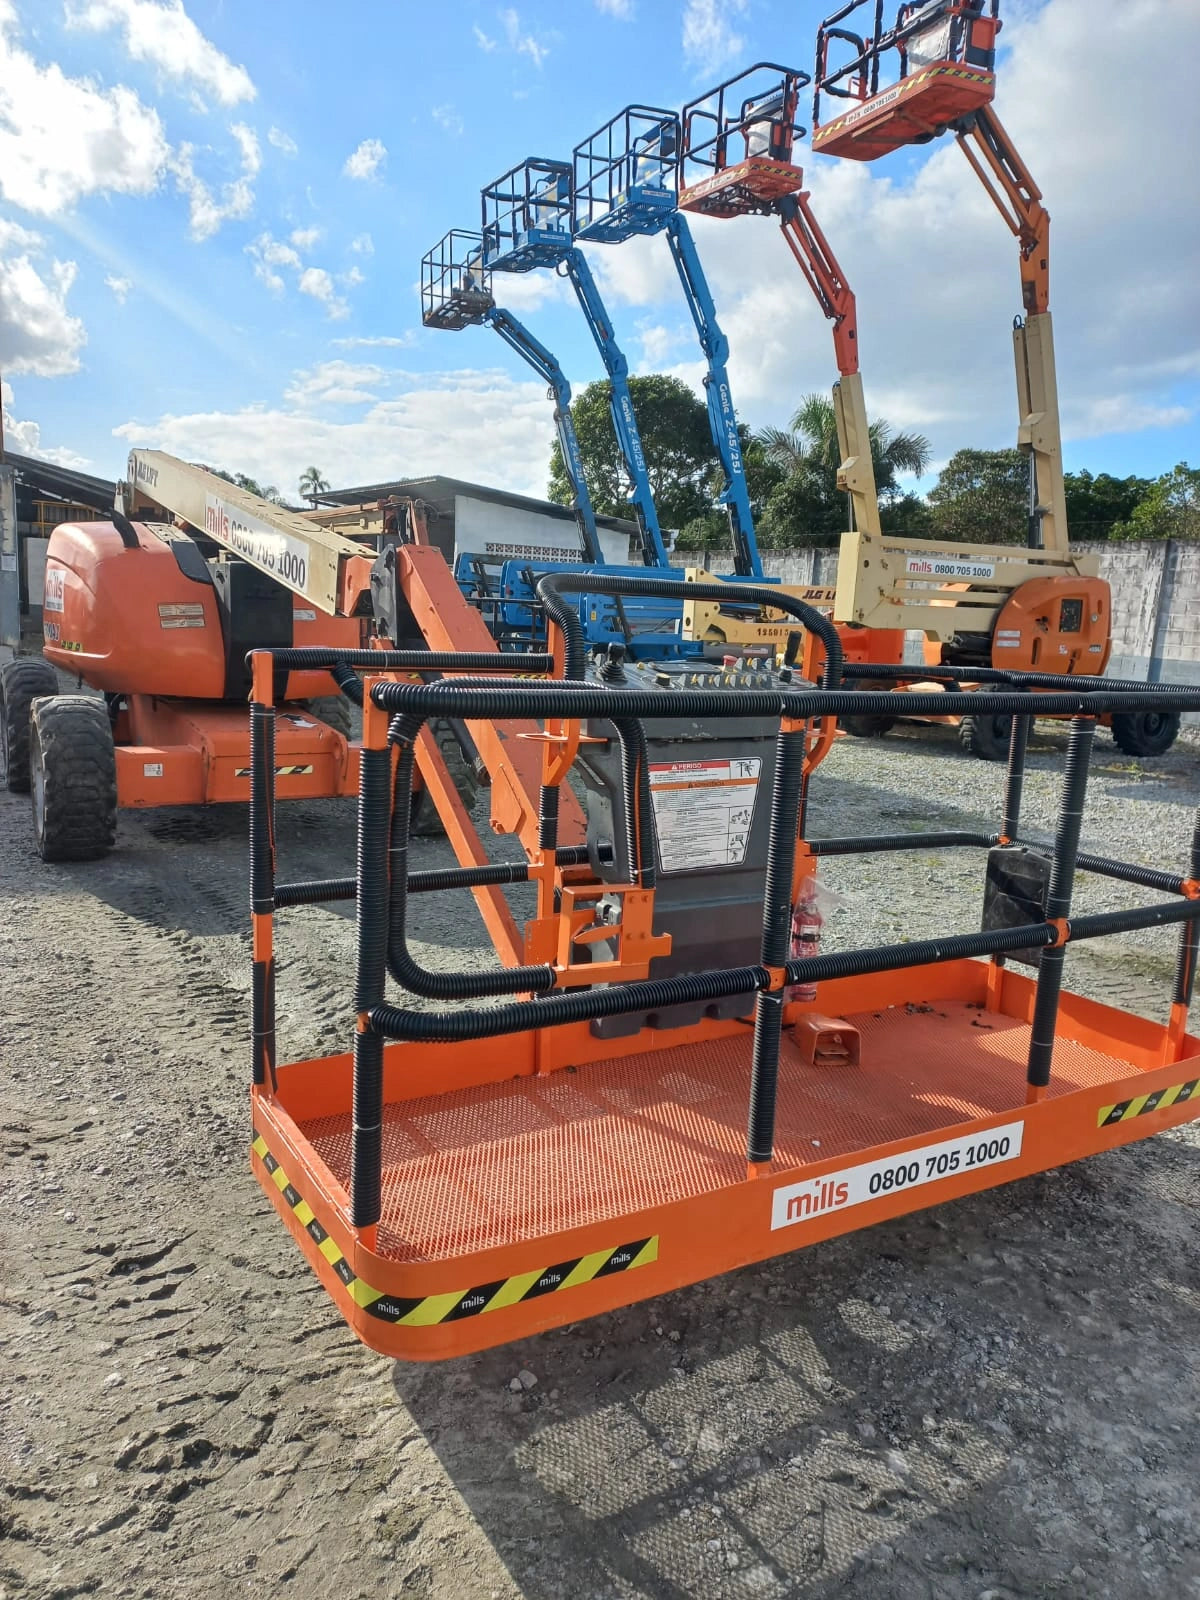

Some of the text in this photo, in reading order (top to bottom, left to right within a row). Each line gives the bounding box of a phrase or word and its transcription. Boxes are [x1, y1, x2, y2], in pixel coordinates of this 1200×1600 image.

[620, 395, 646, 472] Genie Z-45/25J
[719, 383, 742, 474] Genie Z-45/25J
[204, 498, 229, 541] mills
[278, 550, 306, 588] 1000
[906, 559, 992, 578] mills 0800 705 1000
[802, 589, 824, 600] JLG
[784, 1136, 1010, 1221] mills 0800 705 1000
[610, 1252, 631, 1266] mills
[540, 1273, 561, 1287] mills
[377, 1302, 400, 1316] mills
[461, 1295, 485, 1310] mills
